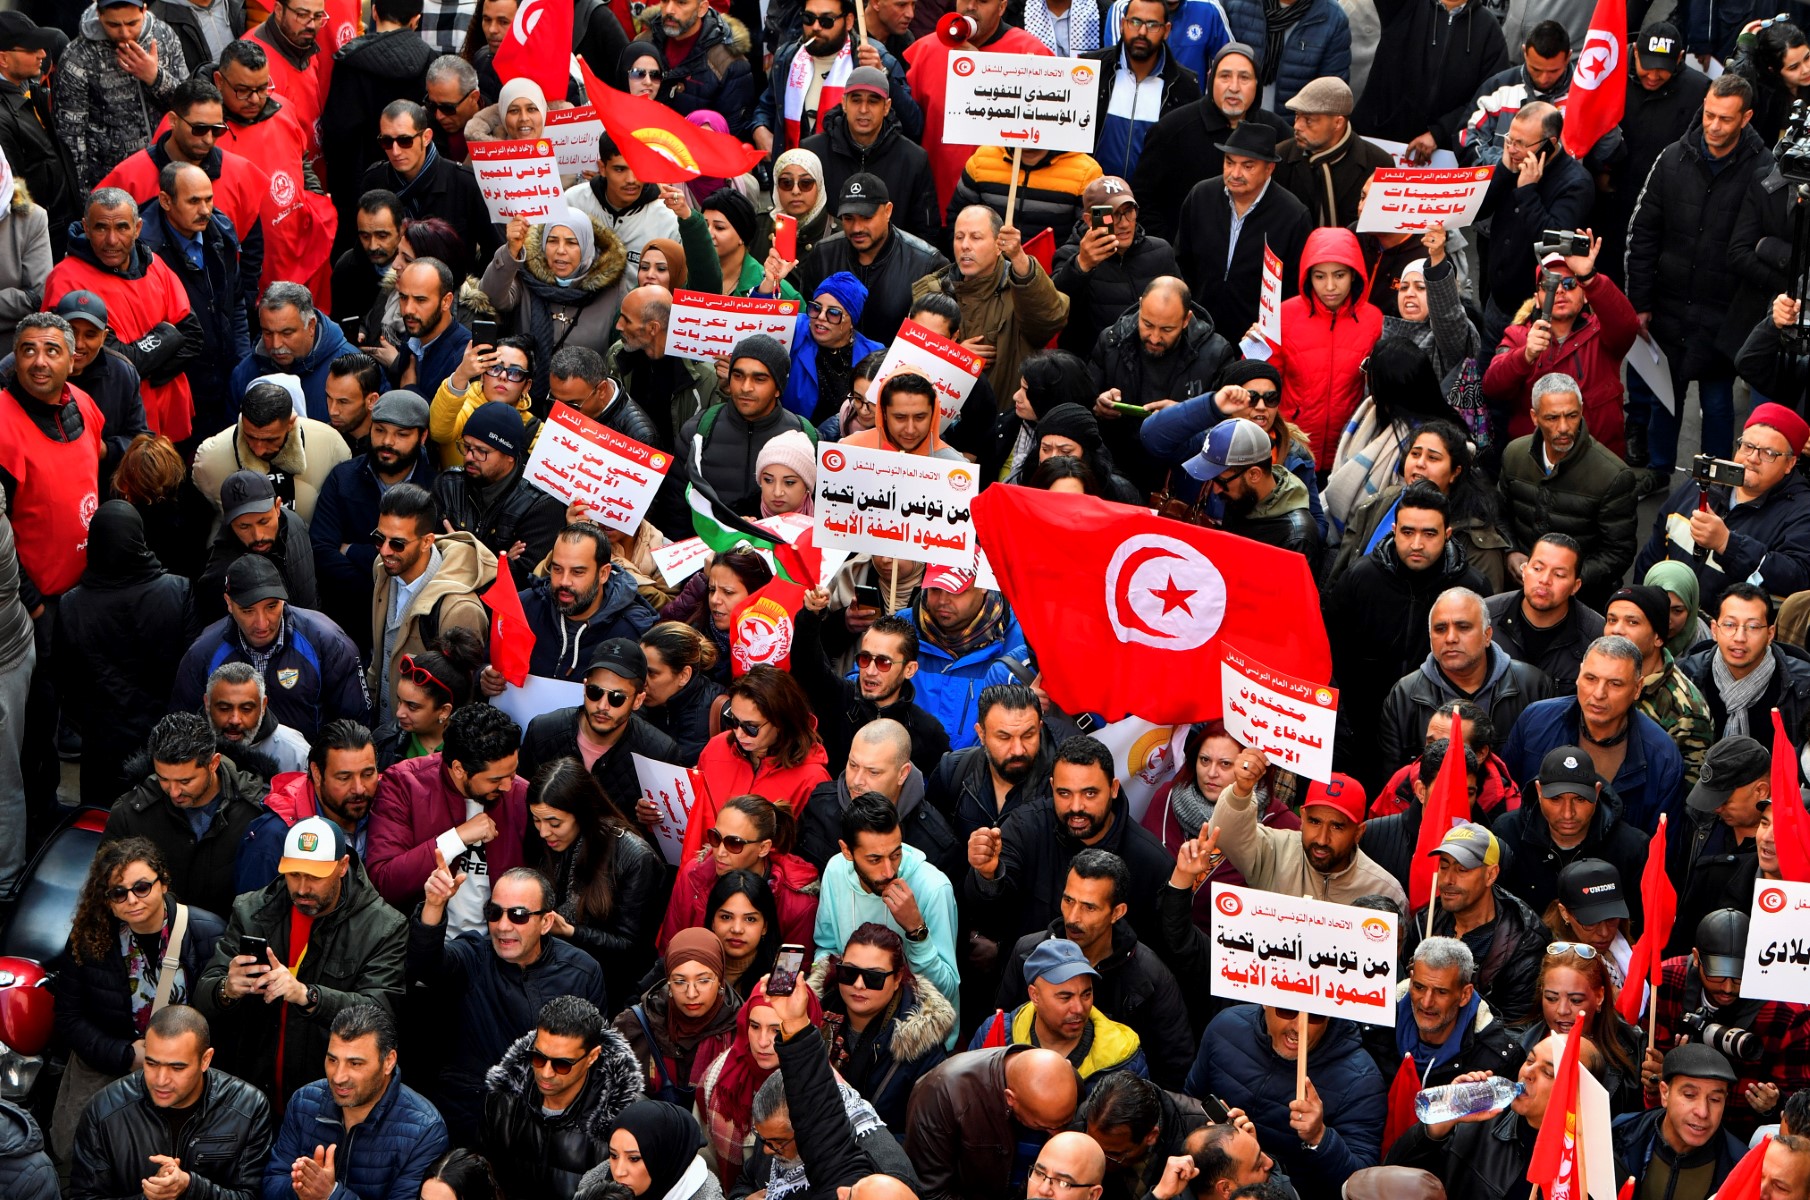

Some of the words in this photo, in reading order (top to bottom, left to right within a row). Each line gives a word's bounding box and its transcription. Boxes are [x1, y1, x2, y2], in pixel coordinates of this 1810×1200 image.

[1648, 36, 1675, 54] CAT
[982, 65, 1003, 74] للشغل
[1003, 66, 1028, 77] التونسي
[1028, 67, 1042, 77] العام
[973, 84, 1023, 101] للتفويت
[964, 102, 1020, 120] العمومية
[1022, 104, 1076, 126] المؤسسات
[1078, 109, 1091, 131] في
[1000, 126, 1040, 144] واجب
[473, 146, 486, 156] للشغل
[487, 147, 507, 158] التونسي
[507, 145, 518, 155] العام
[480, 166, 513, 180] للجميع
[516, 163, 551, 180] تونس
[1381, 172, 1405, 180] للشغل
[1405, 173, 1435, 181] التونسي
[1435, 173, 1452, 181] العام
[503, 184, 560, 201] وبالجميع
[1383, 187, 1475, 201] التعيينات
[1381, 203, 1466, 215] بالكفاءات
[1395, 219, 1428, 230] غير
[680, 294, 704, 303] للشغل
[705, 300, 735, 309] التونسي
[736, 302, 753, 310] العام
[677, 316, 728, 328] تكريس
[734, 320, 763, 333] أجل
[766, 323, 786, 333] من
[672, 328, 733, 344] للحريات
[905, 327, 928, 341] للشغل
[925, 340, 949, 352] التونسي
[947, 349, 961, 359] العام
[934, 377, 961, 400] حماية
[557, 411, 582, 426] للشغل
[580, 426, 611, 441] التونسي
[551, 435, 580, 453] غلاء
[609, 438, 627, 449] العام
[582, 452, 605, 467] من
[852, 460, 875, 471] للشغل
[540, 457, 600, 495] المواطنة
[567, 462, 620, 488] الأسعار
[607, 466, 649, 488] يكفي
[876, 465, 903, 477] التونسي
[902, 468, 917, 478] العام
[533, 472, 573, 500] يعيش
[600, 495, 636, 511] خلي
[857, 484, 897, 512] ألفين
[585, 498, 631, 523] المواط
[901, 494, 943, 521] تونس
[947, 505, 971, 525] من
[913, 527, 967, 550] لصمود
[1226, 652, 1245, 666] للشغل
[1245, 666, 1271, 681] التونسي
[1271, 677, 1288, 688] العام
[1250, 715, 1269, 730] عن
[1273, 725, 1323, 749] للدفاع
[1589, 883, 1616, 894] UNIONS
[1251, 905, 1277, 917] للشغل
[1278, 911, 1308, 924] التونسي
[1309, 914, 1327, 926] العام
[1328, 917, 1353, 930] الاتحاد
[1258, 933, 1303, 962] ألفين
[1308, 945, 1358, 974] تونس
[1362, 957, 1390, 979] من
[1324, 981, 1386, 1008] لصمود
